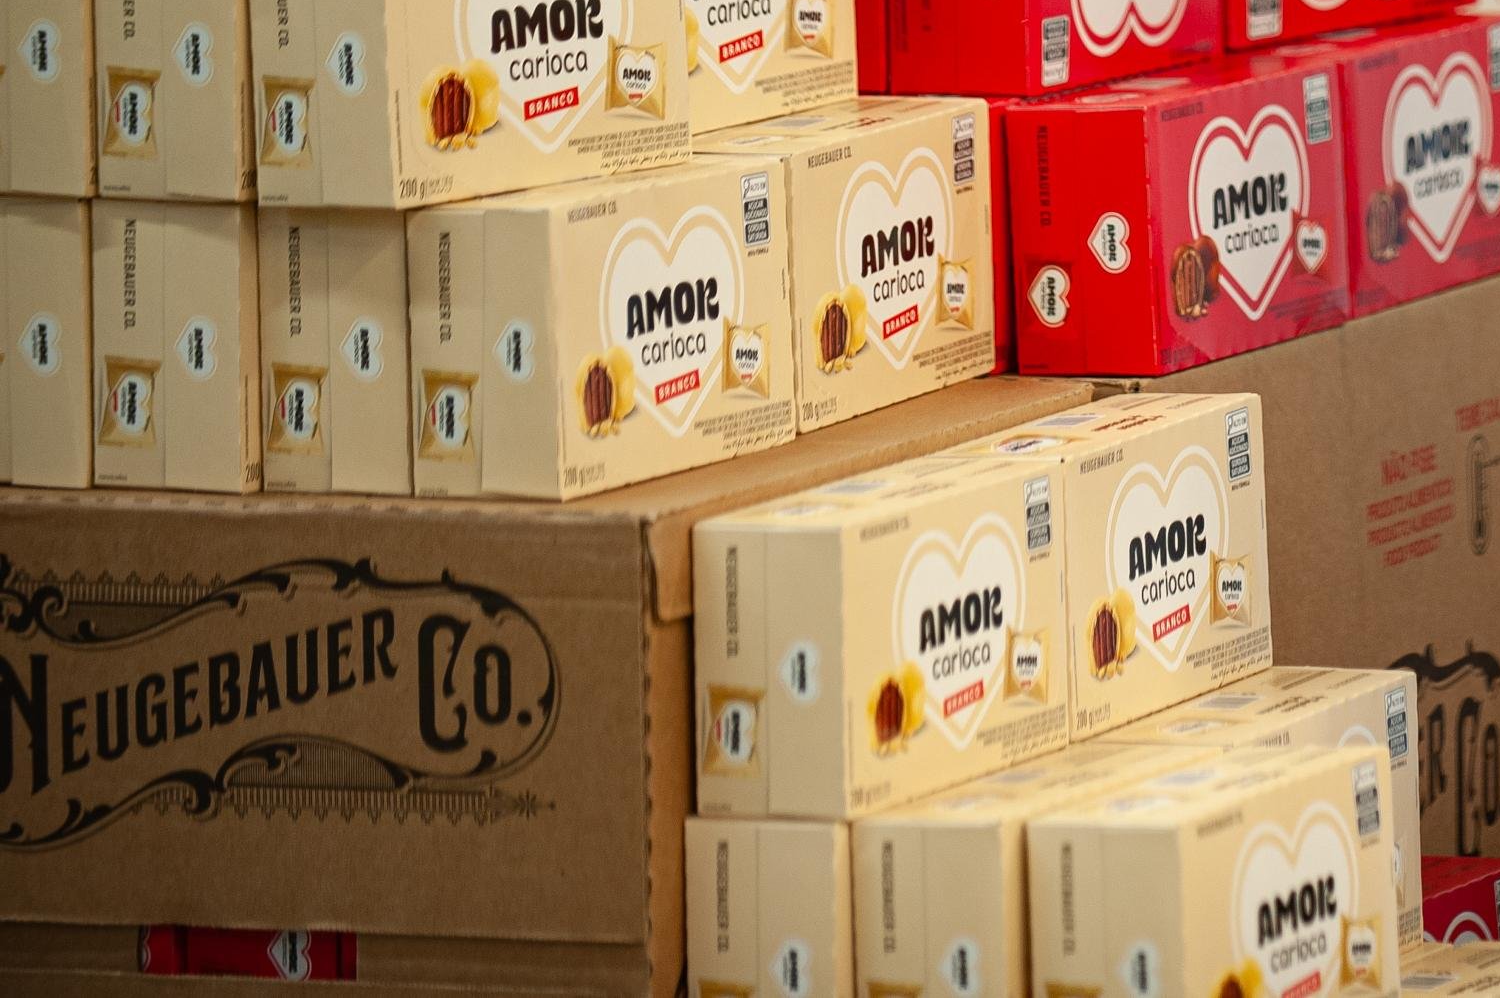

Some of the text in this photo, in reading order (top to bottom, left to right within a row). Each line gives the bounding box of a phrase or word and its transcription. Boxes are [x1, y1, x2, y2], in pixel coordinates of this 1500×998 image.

[721, 34, 761, 59] BRANCO
[343, 43, 353, 86] AMOR
[509, 50, 588, 81] carioca
[623, 68, 651, 81] AMOR
[527, 91, 576, 116] BRANCO
[283, 101, 293, 144] AMOR
[808, 148, 843, 169] NEUGEBAUER
[1405, 120, 1472, 177] AMOR
[400, 180, 417, 198] 200
[1213, 172, 1287, 230] AMOR
[567, 204, 606, 224] NEUGEBAUER
[861, 215, 935, 279] AMOR
[1107, 224, 1116, 262] AMOR
[1225, 223, 1279, 255] carioca
[125, 219, 135, 307] NEUGEBAUER
[289, 226, 300, 312] NEUGEBAUER
[873, 269, 925, 302] carioca
[1047, 277, 1056, 316] AMOR
[626, 277, 719, 340] AMOR
[884, 308, 917, 337] BRANCO
[641, 331, 706, 365] carioca
[735, 348, 758, 362] AMOR
[658, 374, 697, 401] BRANCO
[1080, 453, 1115, 475] NEUGEBAUER
[1128, 513, 1207, 581] AMOR
[1141, 566, 1196, 605] carioca
[1222, 580, 1242, 594] AMOR
[919, 585, 1002, 653] AMOR
[1154, 608, 1188, 640] BRANCO
[932, 642, 991, 680] carioca
[1016, 654, 1038, 668] AMOR
[0, 608, 398, 797] NEUGEBAUER
[945, 683, 982, 716] BRANCO
[1076, 710, 1087, 731] 200
[1258, 874, 1338, 948] AMOR
[1270, 933, 1327, 974] carioca
